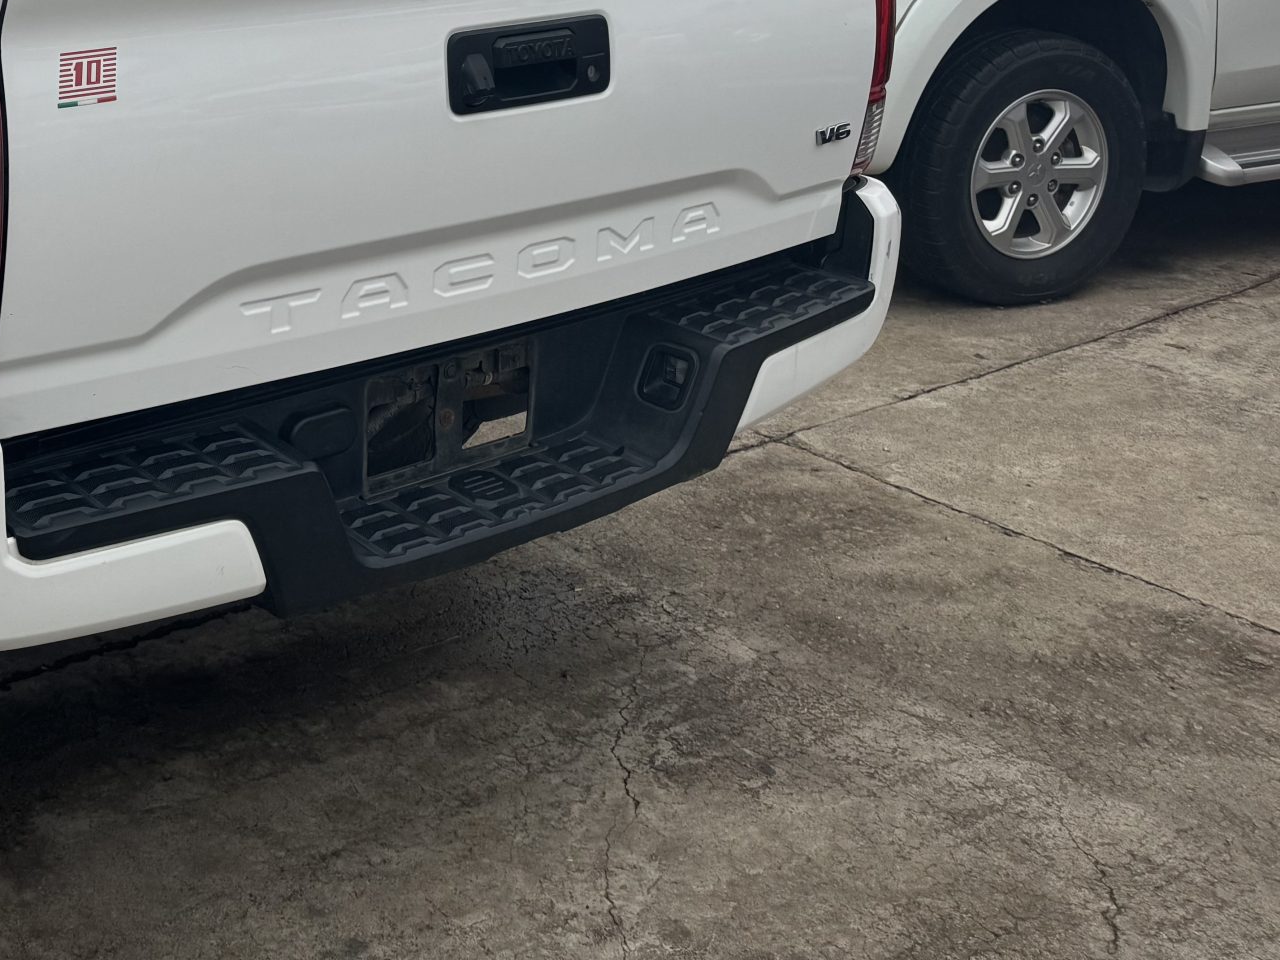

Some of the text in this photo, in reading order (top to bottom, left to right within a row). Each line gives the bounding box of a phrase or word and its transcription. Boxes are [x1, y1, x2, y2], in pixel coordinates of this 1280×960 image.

[73, 58, 102, 87] 10
[815, 121, 851, 145] V6
[239, 200, 722, 335] TACOMA
